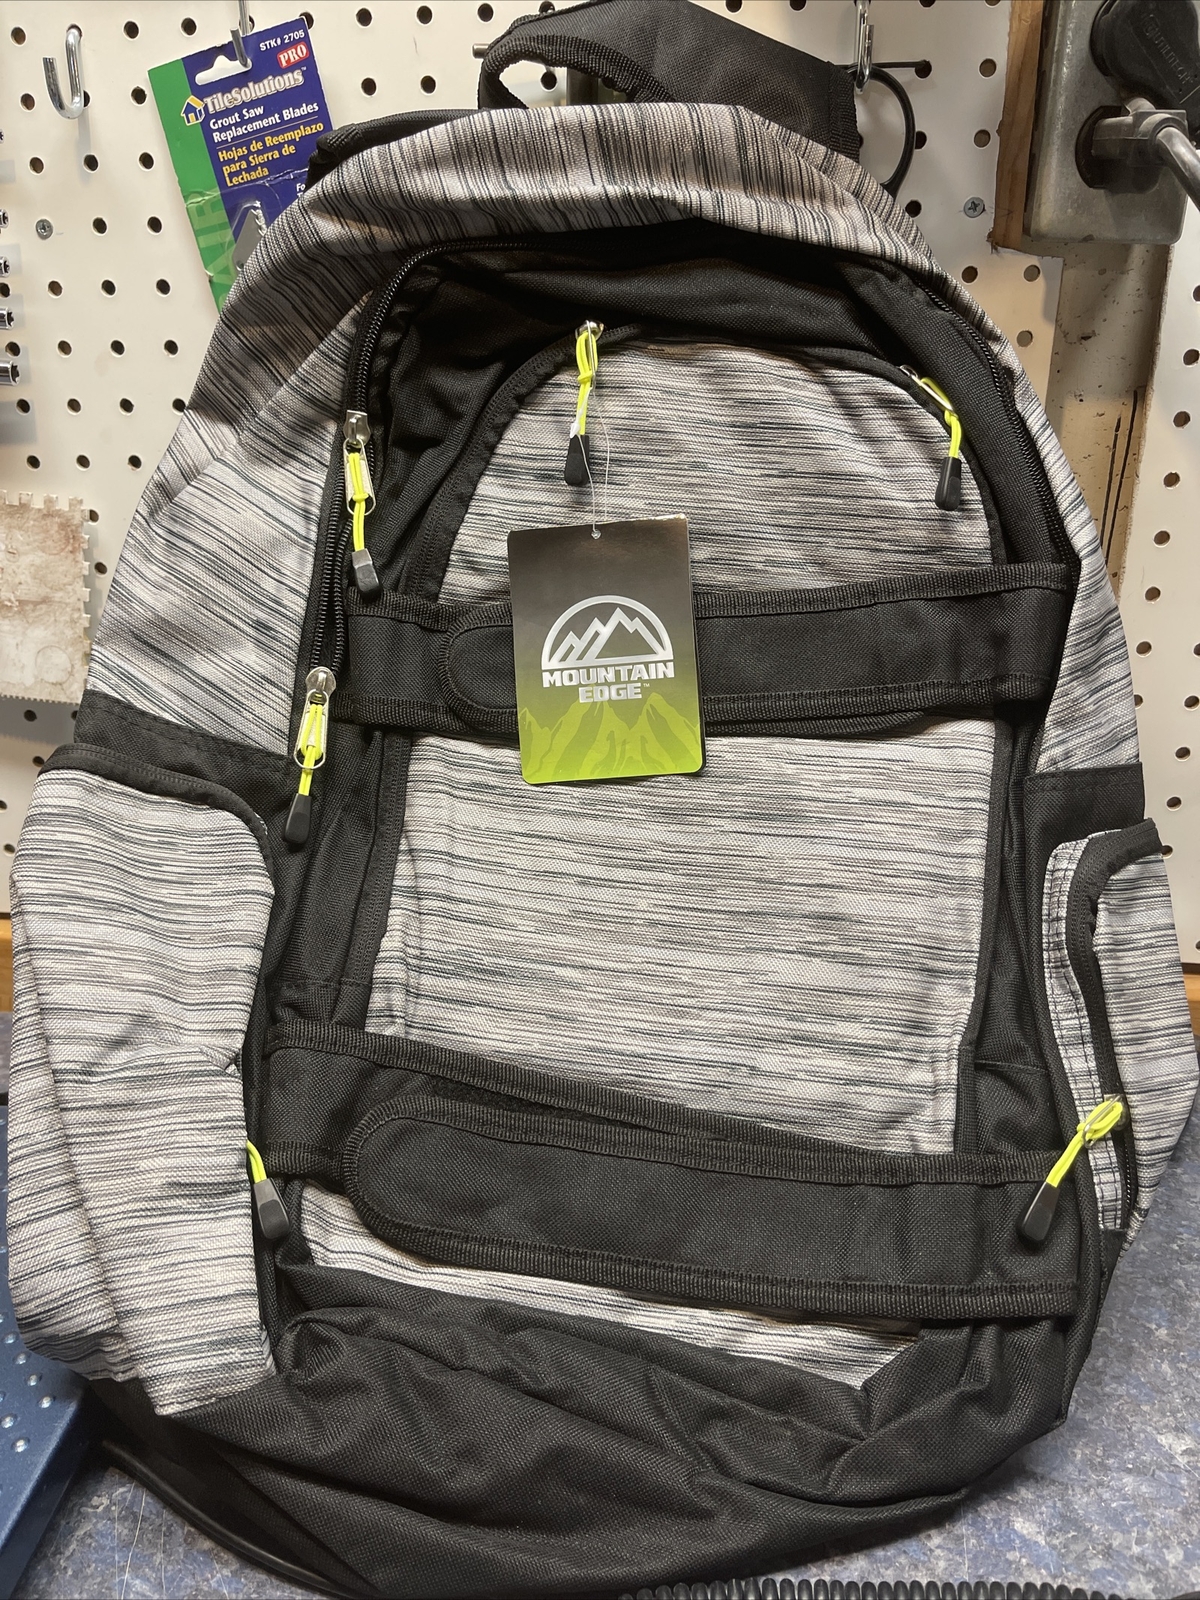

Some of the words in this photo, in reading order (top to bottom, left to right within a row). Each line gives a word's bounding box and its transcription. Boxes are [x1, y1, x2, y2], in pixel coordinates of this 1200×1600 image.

[259, 39, 282, 51] STK#
[283, 29, 305, 44] 2705
[278, 43, 307, 67] PRO
[204, 70, 304, 113] TileSolutions
[209, 115, 241, 130] Grout
[243, 105, 265, 120] Saw
[213, 115, 281, 142] Replacement
[283, 102, 319, 121] Blades
[218, 148, 248, 162] Hojas
[250, 139, 264, 152] de
[264, 122, 324, 147] Reemplazo
[222, 161, 247, 176] para
[248, 151, 280, 167] Sierra
[281, 144, 296, 155] de
[225, 167, 269, 187] Lechada
[542, 661, 675, 687] MOUNTAIN
[579, 683, 642, 703] EDGE
